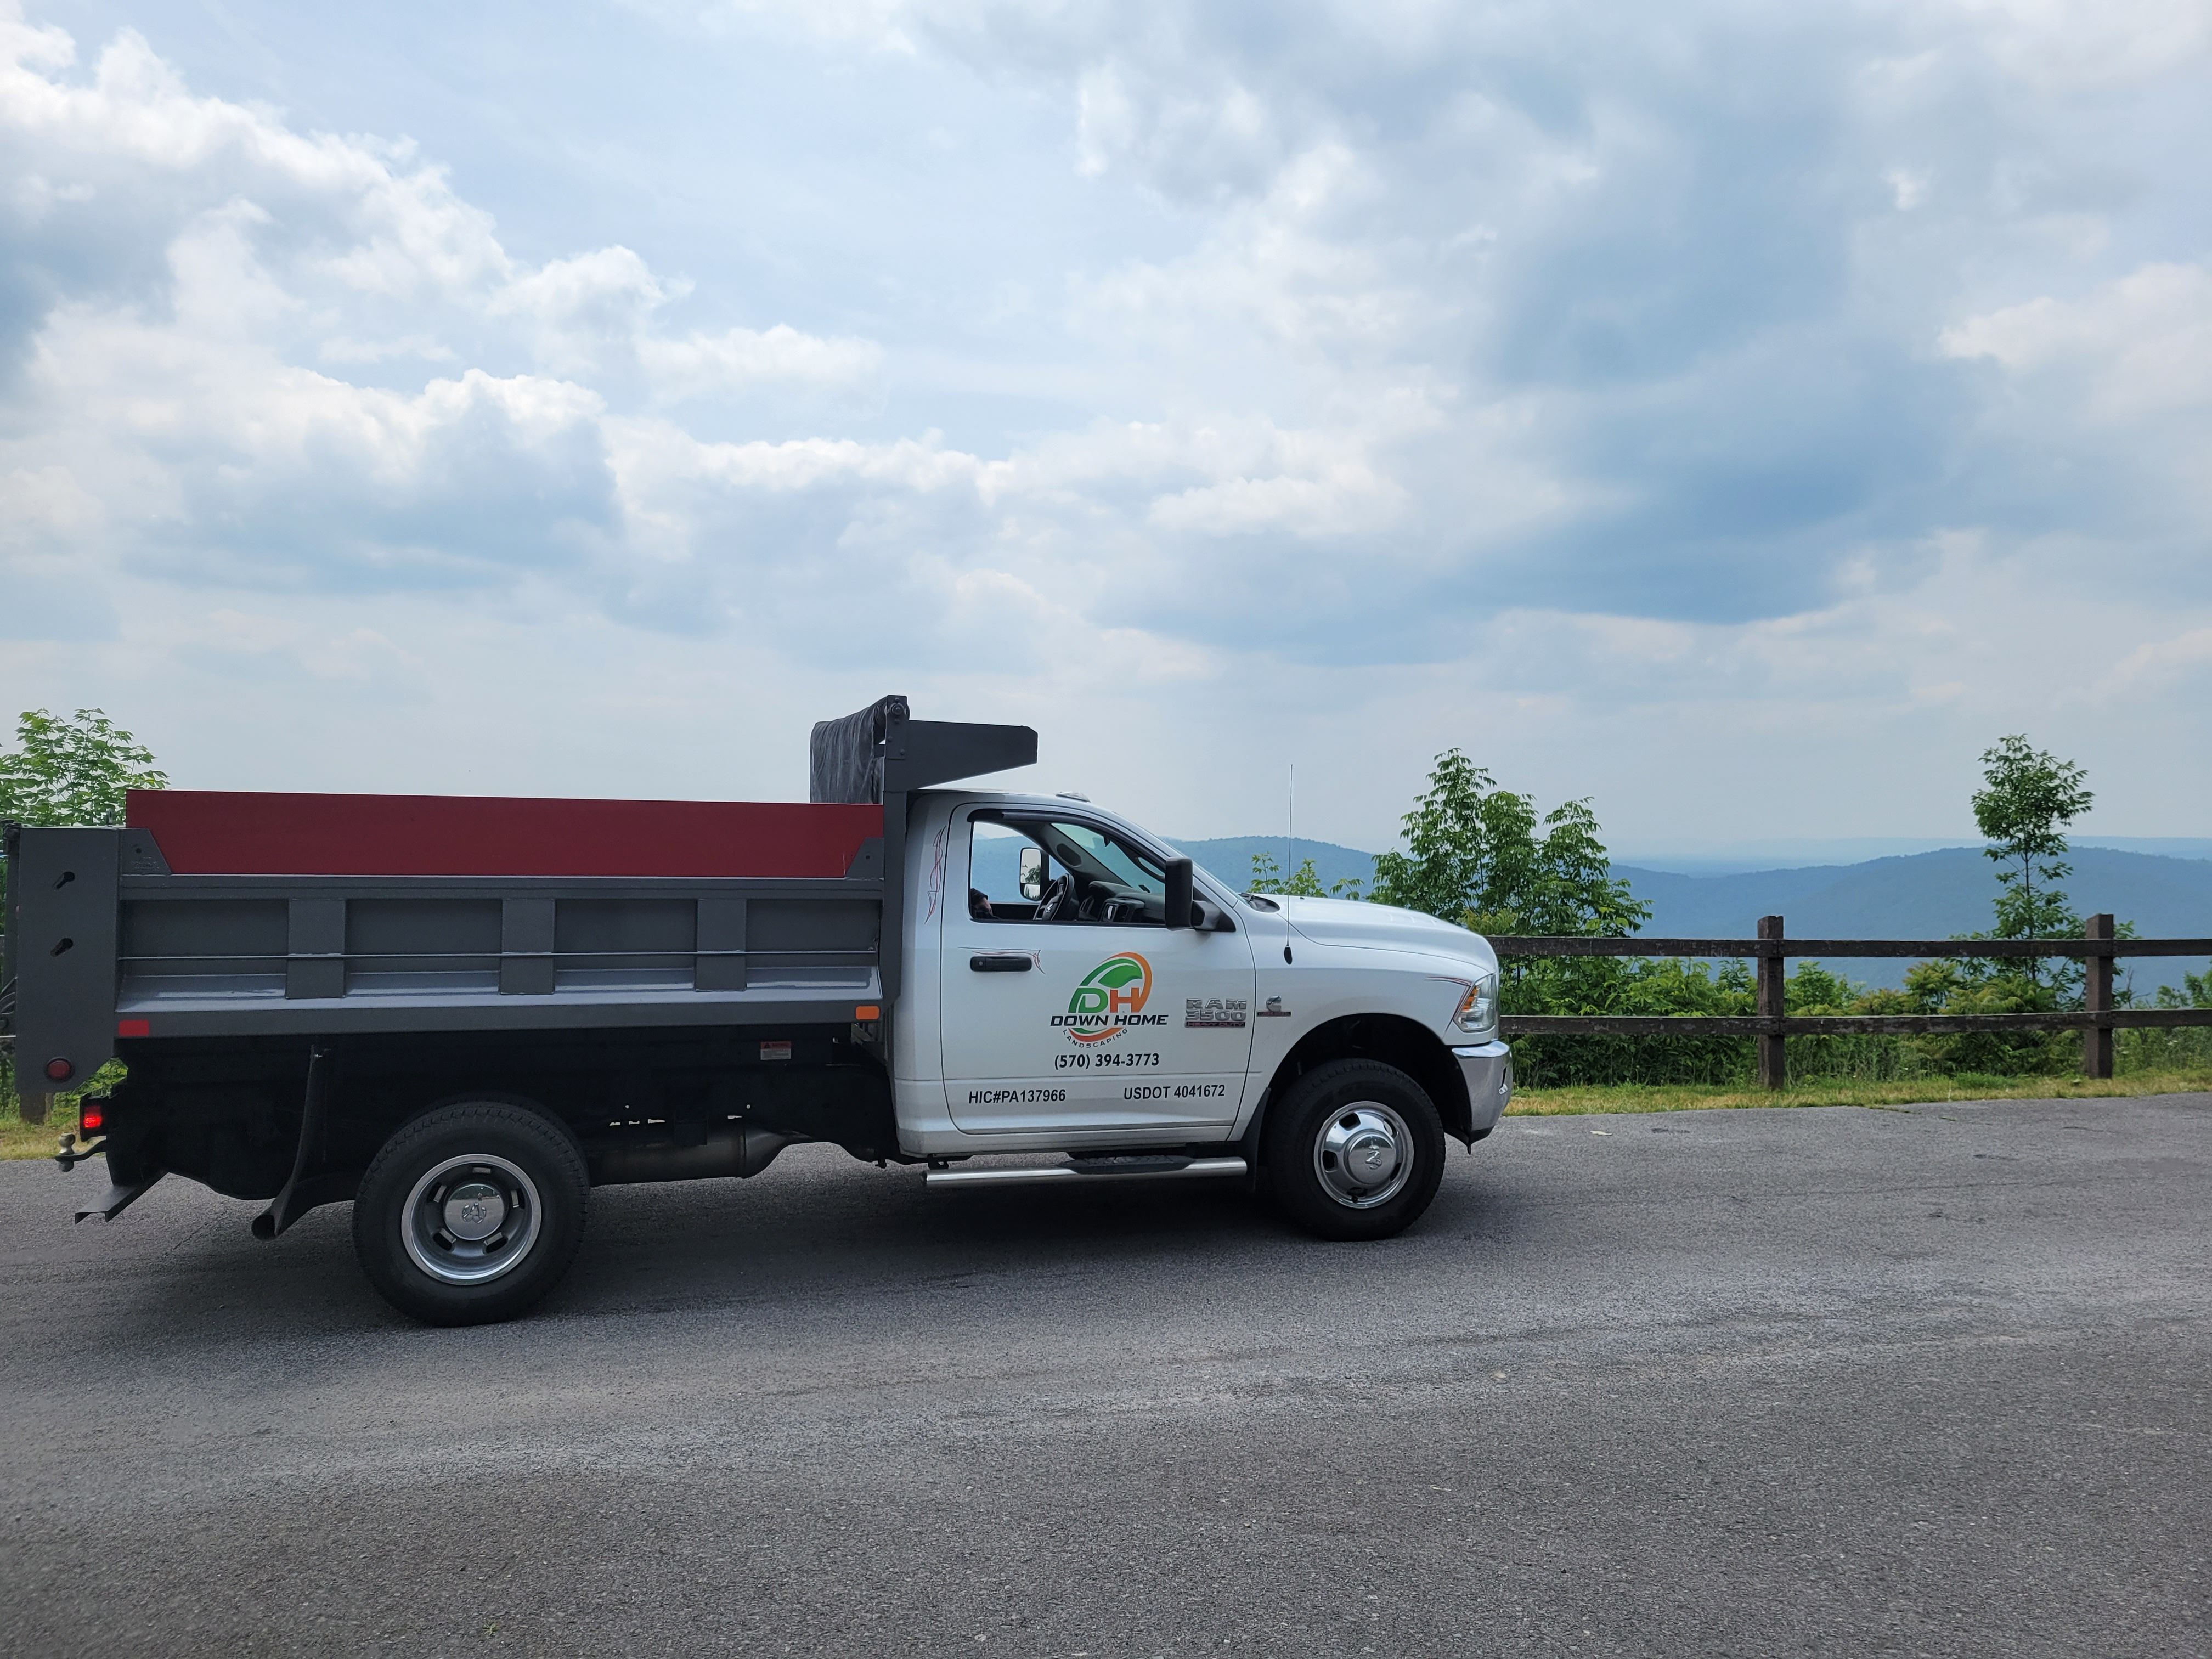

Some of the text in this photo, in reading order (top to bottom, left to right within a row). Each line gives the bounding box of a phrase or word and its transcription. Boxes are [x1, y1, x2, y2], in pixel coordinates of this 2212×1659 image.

[1068, 987, 1147, 1013] DH
[1186, 998, 1247, 1009] RAM
[1050, 1014, 1169, 1026] DOWN HOME
[1185, 1009, 1246, 1021] 3500
[1063, 1028, 1128, 1048] LANDSCAPING
[1054, 1053, 1159, 1070] (570) 394-3773
[968, 1088, 1066, 1104] HIC#PA137966
[1124, 1084, 1225, 1100] USDOT 4041672
